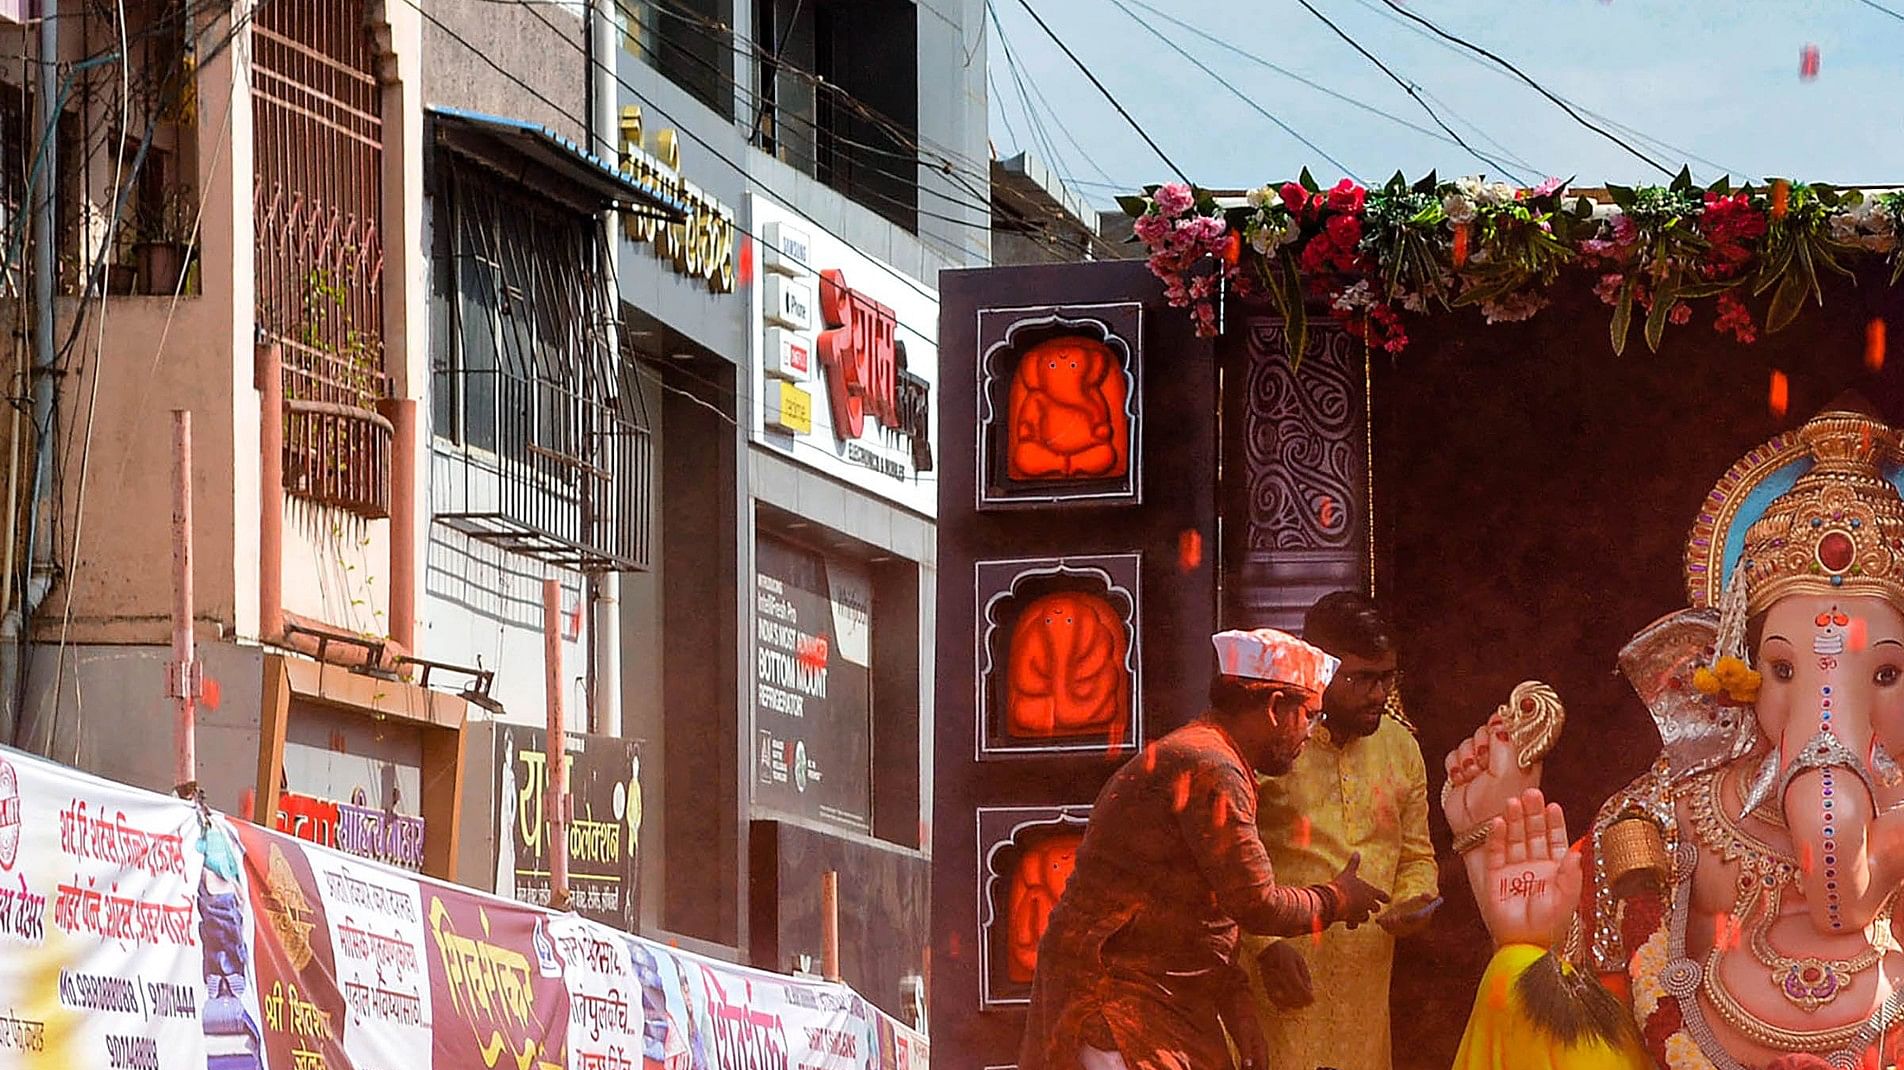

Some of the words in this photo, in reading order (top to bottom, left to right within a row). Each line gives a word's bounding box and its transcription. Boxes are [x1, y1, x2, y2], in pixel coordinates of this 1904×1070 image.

[758, 647, 796, 688] BOTTOM
[797, 658, 828, 699] MOUNT
[758, 683, 804, 718] REFRIGERATOR
[570, 803, 621, 864] कलेक्शन
[264, 980, 284, 1035] श्री
